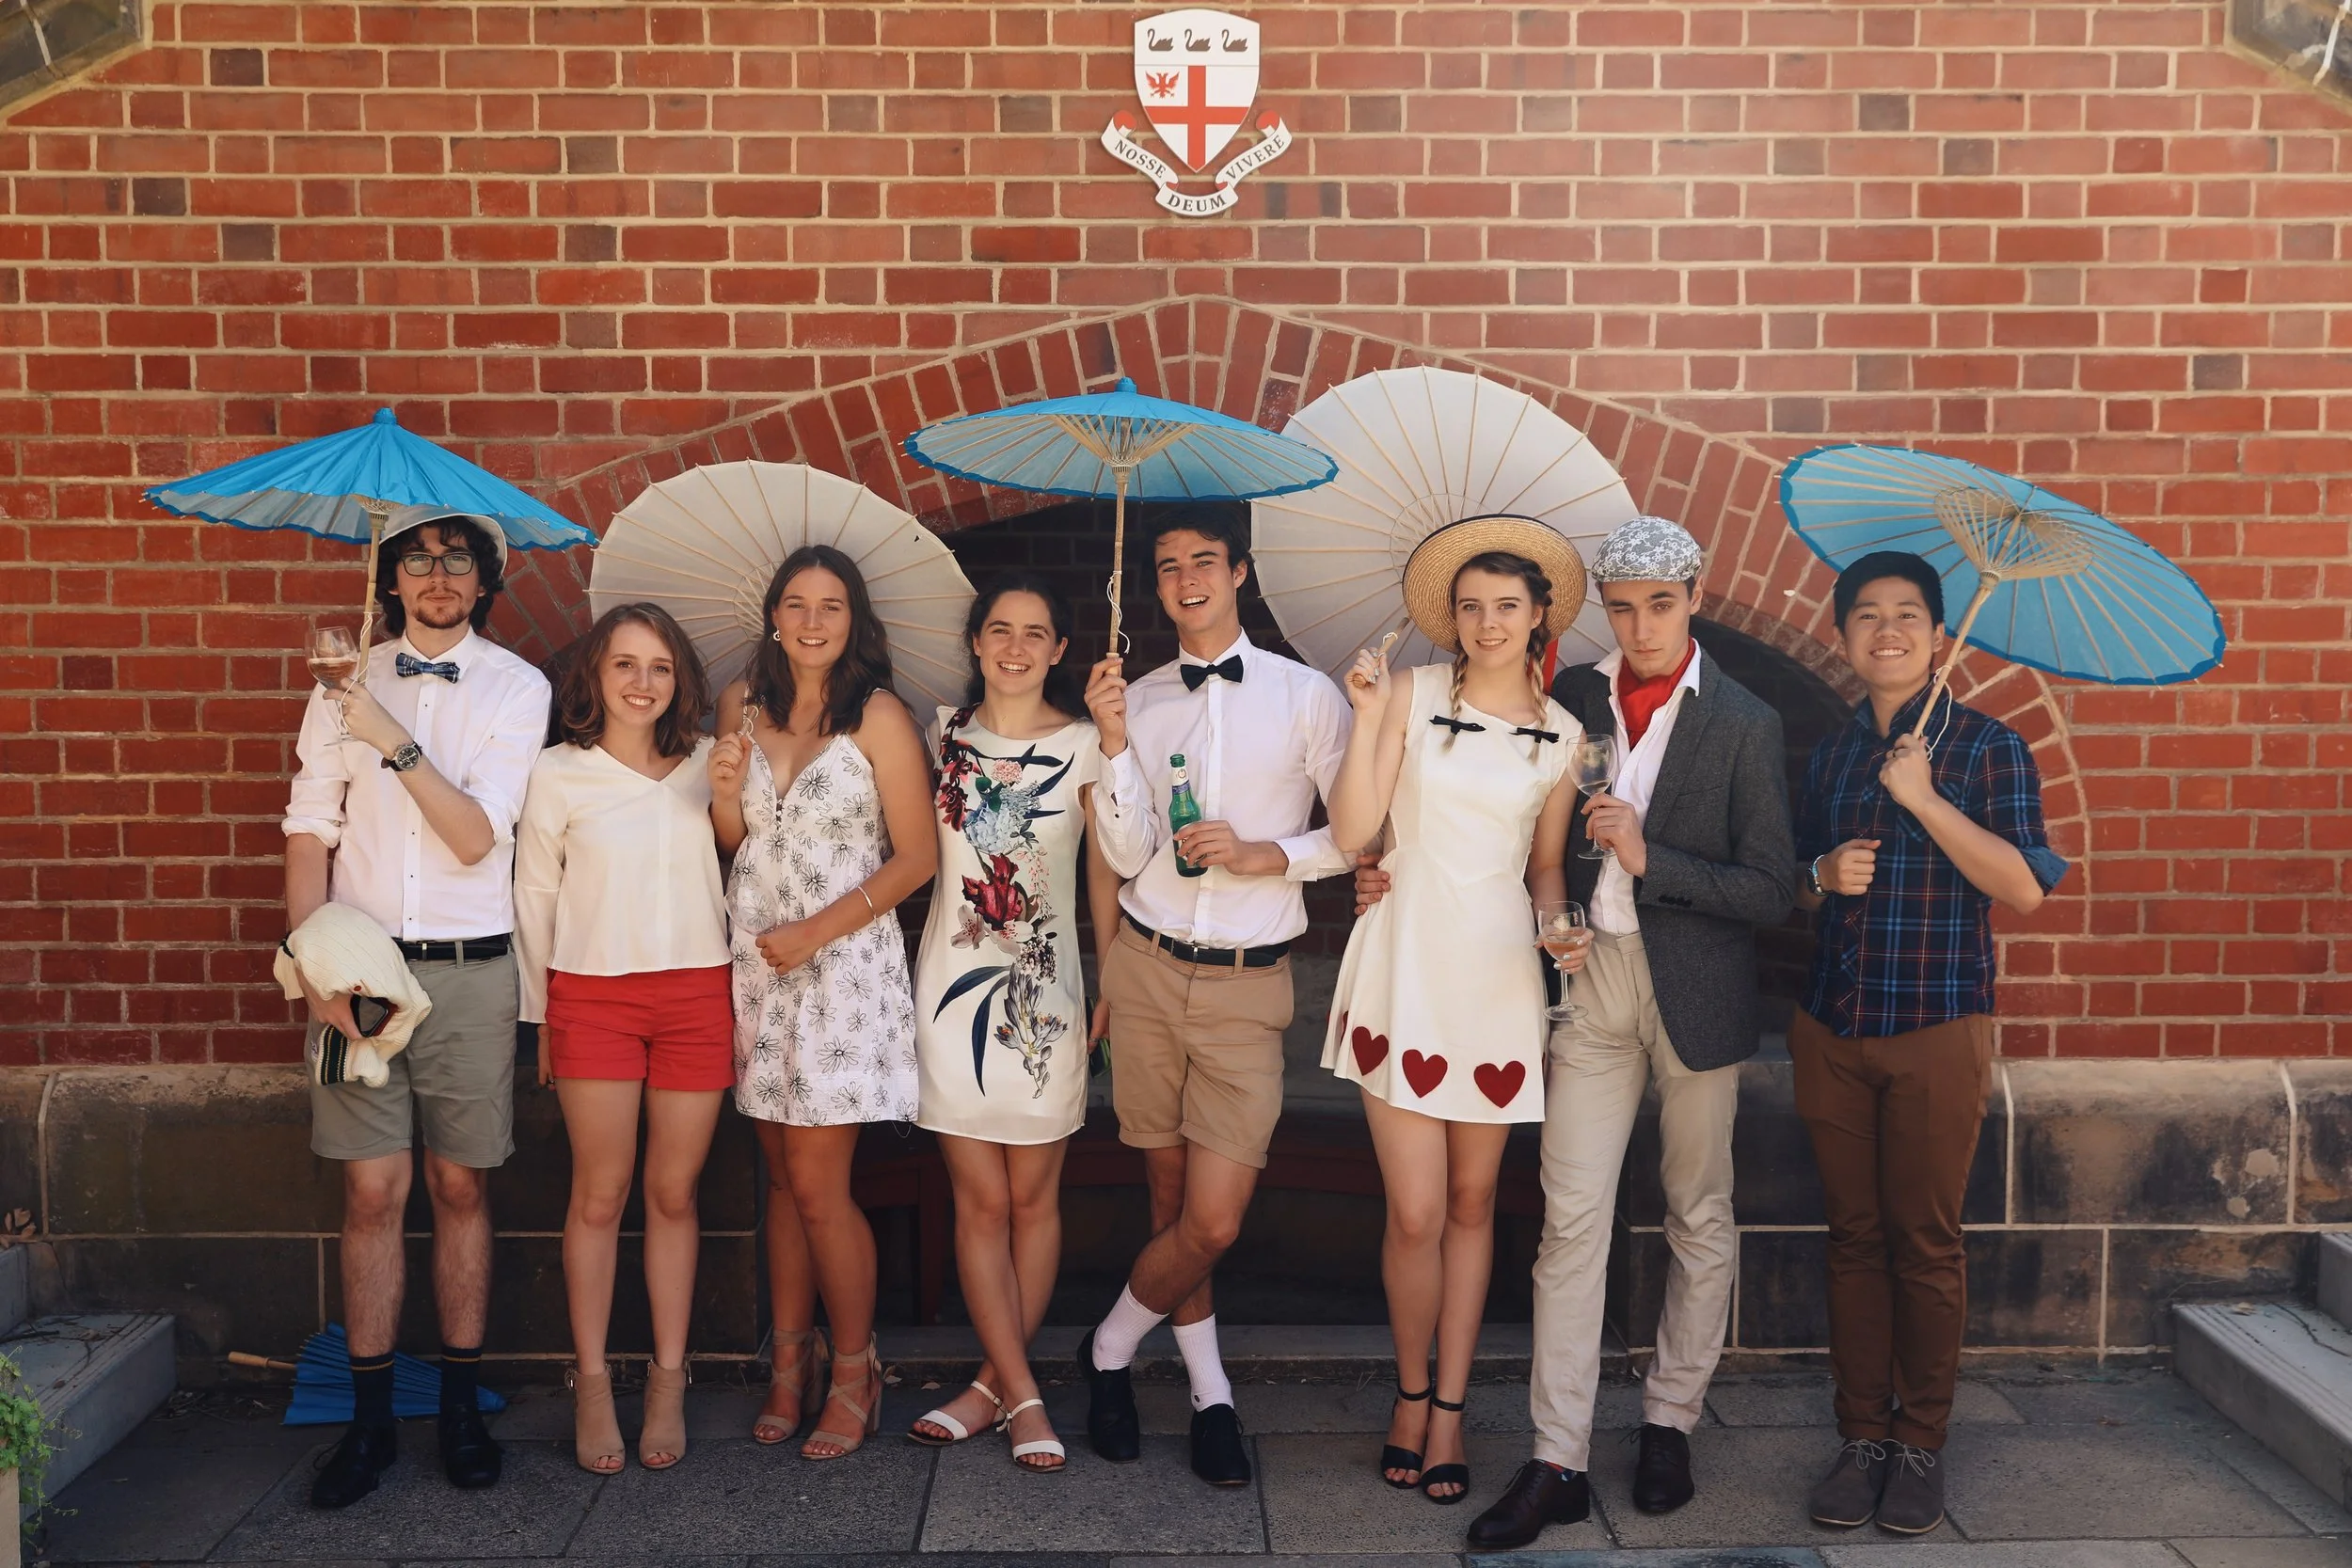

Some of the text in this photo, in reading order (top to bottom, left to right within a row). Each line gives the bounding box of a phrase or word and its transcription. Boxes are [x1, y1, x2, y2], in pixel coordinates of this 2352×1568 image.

[1115, 135, 1285, 213] NOSSE DEUM VIVERE
